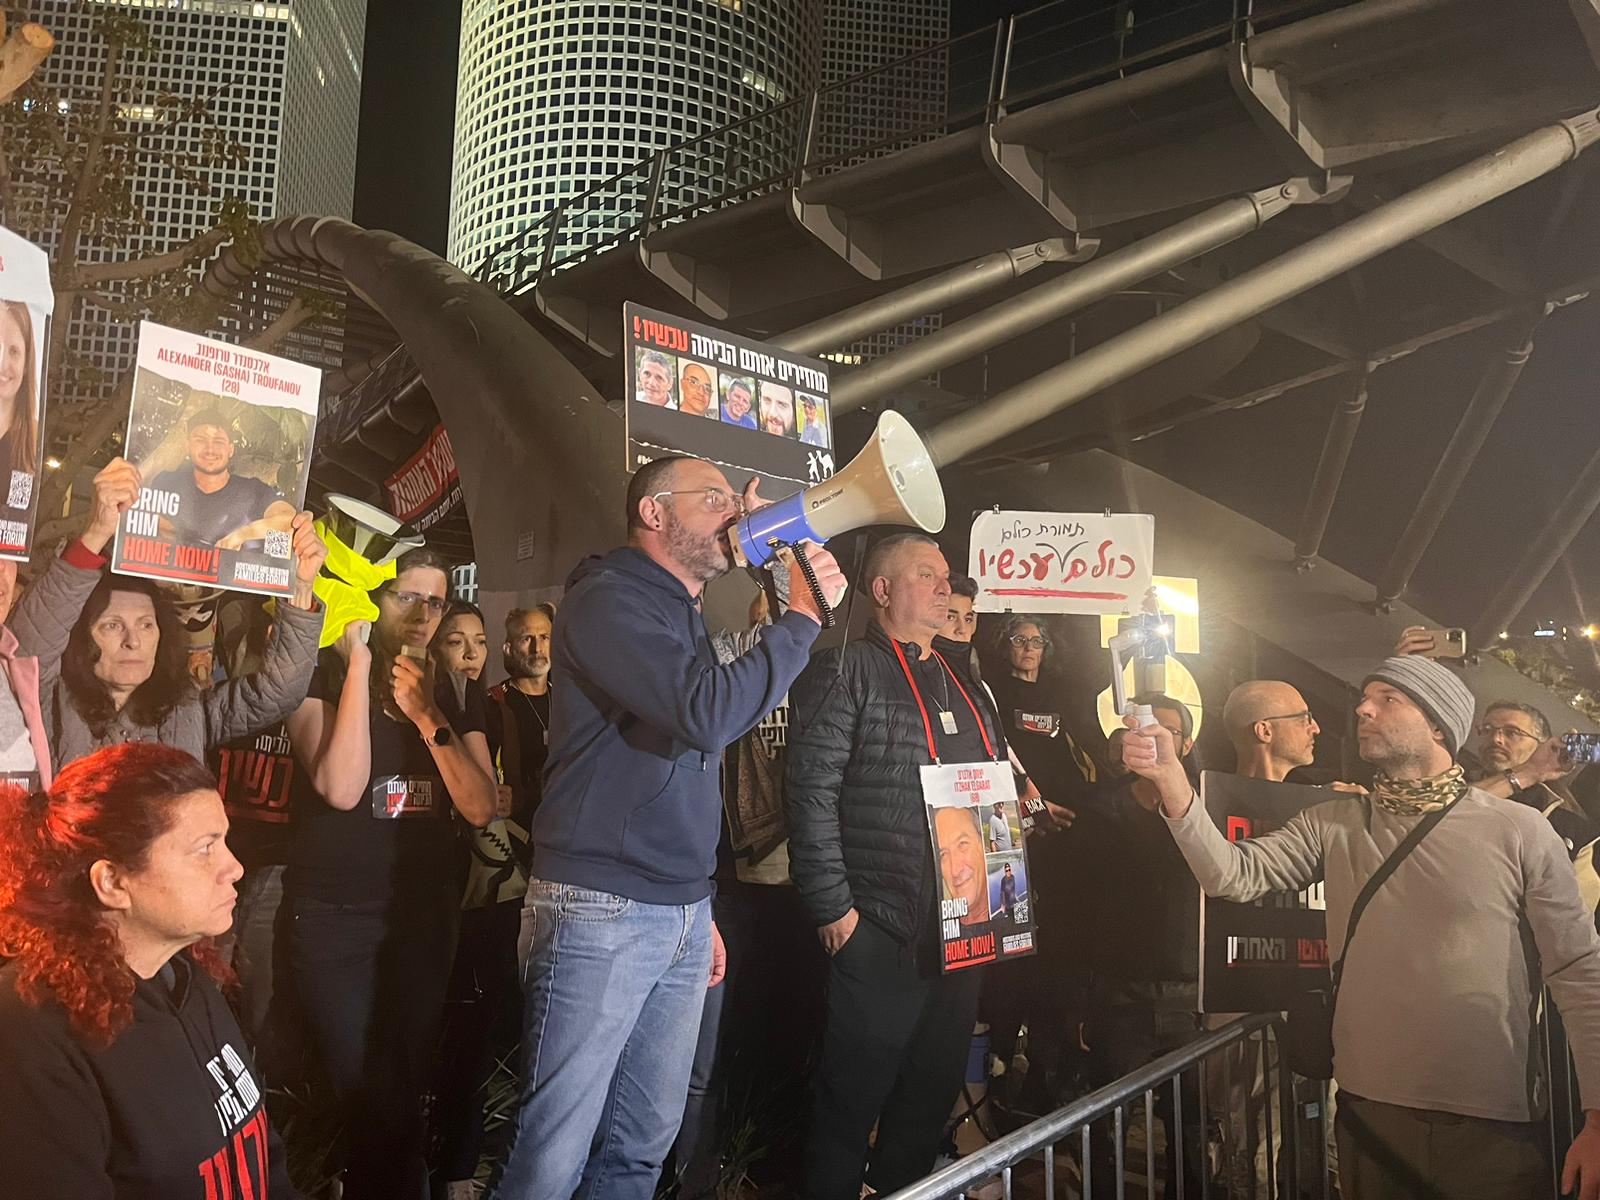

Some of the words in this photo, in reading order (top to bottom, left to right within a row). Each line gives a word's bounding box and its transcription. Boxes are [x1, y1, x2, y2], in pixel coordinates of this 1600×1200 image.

[633, 316, 689, 352] עכשיו!
[196, 343, 231, 363] טרופנוב
[233, 352, 270, 373] אלכסנדר
[691, 333, 736, 366] הביתה
[740, 347, 776, 377] אותם
[157, 348, 211, 373] ALEXANDER
[213, 362, 250, 384] (SASHA)
[252, 373, 302, 396] TROUFANOV
[777, 359, 829, 394] מחזירים
[222, 380, 240, 395] (28)
[125, 509, 160, 537] HIM
[1001, 519, 1031, 543] כולם
[1035, 522, 1085, 537] תמורת
[3, 530, 27, 547] FORUM
[123, 536, 171, 566] HOME
[174, 546, 220, 573] NOW!
[979, 548, 1055, 581] עכשיו
[1060, 540, 1136, 584] כולם
[234, 569, 264, 583] FAMILIES
[264, 573, 289, 585] FORUM
[1025, 797, 1046, 814] BACK
[941, 897, 968, 920] BRING
[943, 918, 961, 940] HIM
[944, 939, 970, 962] HOME
[971, 932, 996, 957] NOW!
[1226, 936, 1286, 964] האחרון
